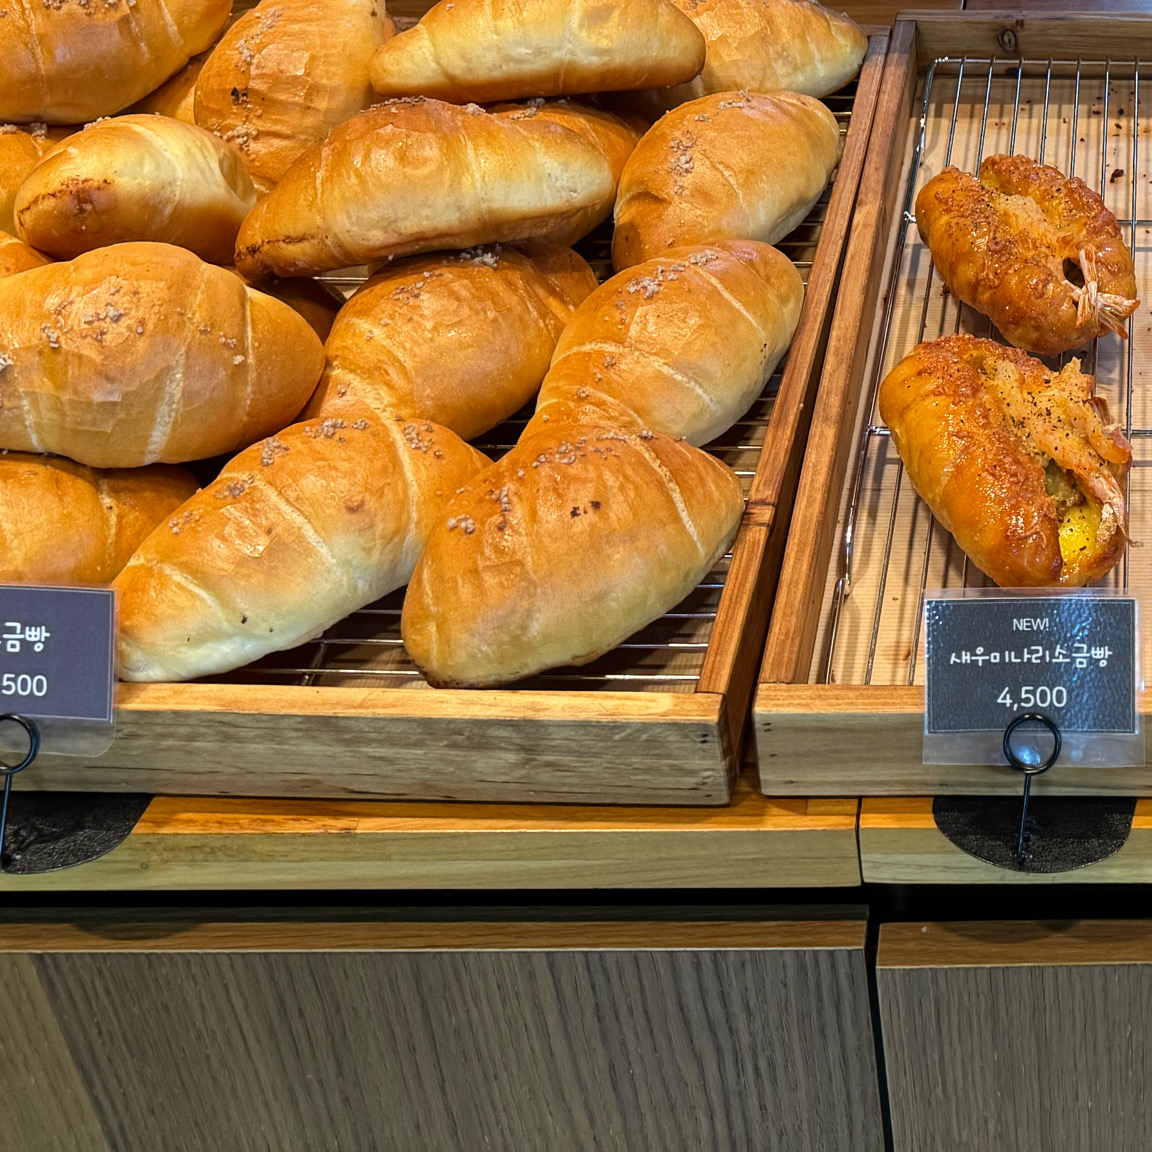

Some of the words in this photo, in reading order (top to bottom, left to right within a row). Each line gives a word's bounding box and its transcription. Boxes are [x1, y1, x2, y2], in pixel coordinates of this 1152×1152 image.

[0, 621, 51, 653] 금빵
[1012, 618, 1050, 631] NEW!
[950, 643, 1113, 668] 새우미나리소금빵
[996, 686, 1068, 711] 4,500
